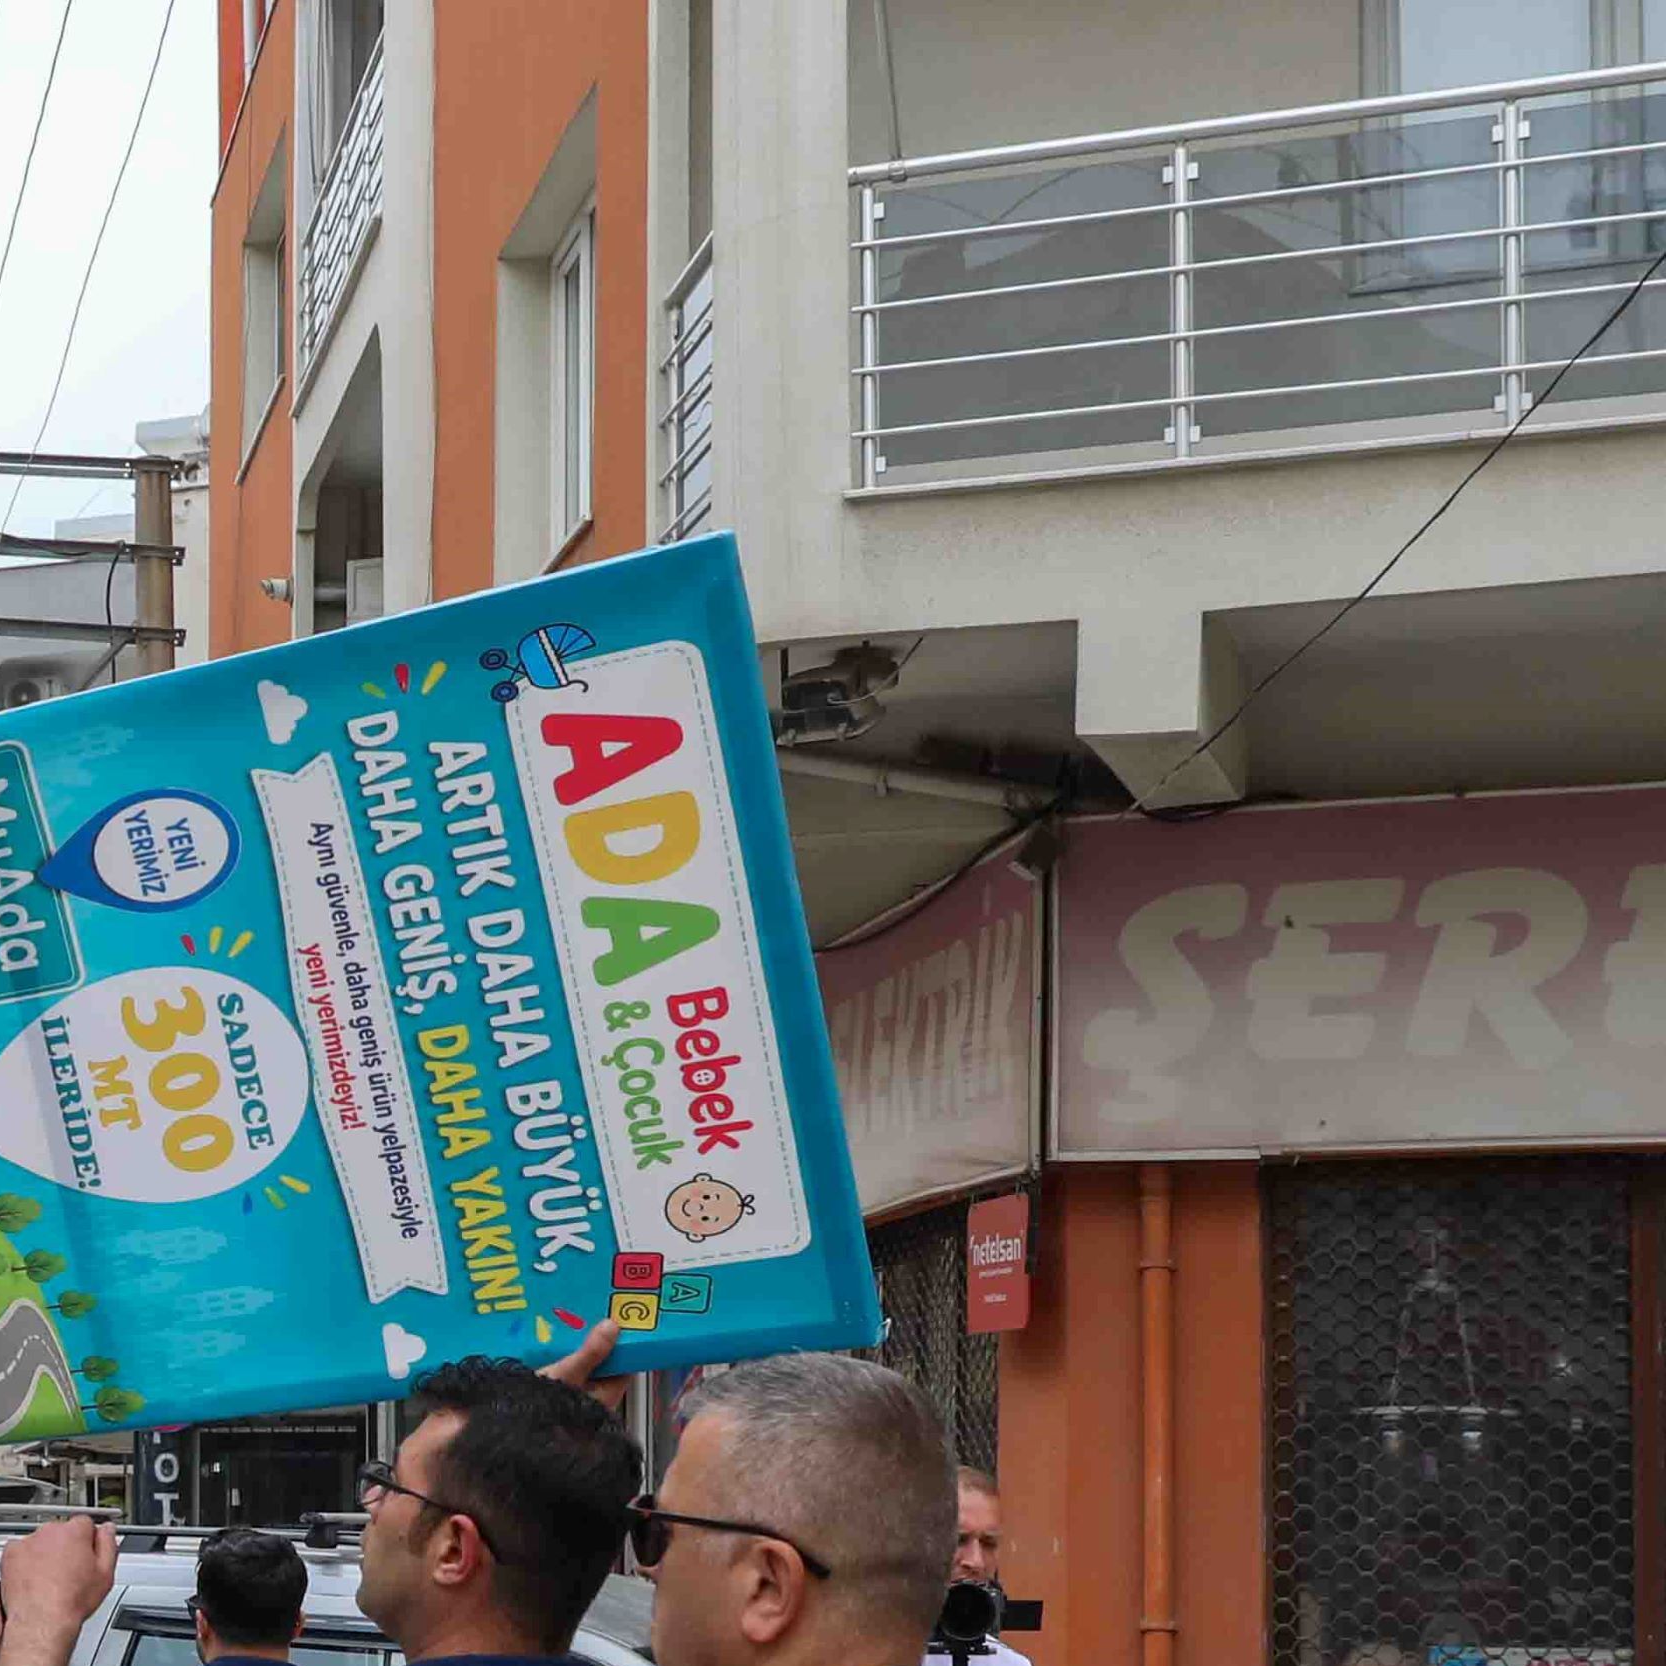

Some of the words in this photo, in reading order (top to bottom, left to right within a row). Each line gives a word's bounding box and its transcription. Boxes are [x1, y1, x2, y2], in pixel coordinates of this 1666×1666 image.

[165, 816, 207, 872] YENİ
[307, 821, 338, 868] Aynı
[347, 710, 423, 854] DAHA
[427, 741, 516, 897] ARTIK
[541, 713, 721, 986] ADA
[124, 809, 170, 897] YERİMİZ
[316, 873, 360, 957] güvenle,
[297, 943, 335, 990] yeni
[343, 961, 372, 1012] daha
[383, 863, 467, 1016] GENİŞ,
[467, 907, 551, 1069] DAHA
[120, 985, 235, 1173] 300
[218, 992, 275, 1150] SADECE
[307, 992, 368, 1131] yerimizdeyiz!
[348, 1015, 387, 1068] geniş
[603, 1000, 651, 1032] &
[666, 986, 754, 1155] Bebek
[41, 1014, 102, 1189] İLERİDE!
[87, 1055, 143, 1131] MT
[368, 1072, 396, 1119] ürün
[418, 1024, 491, 1159] DAHA
[601, 1037, 685, 1170] Çocuk
[373, 1121, 423, 1240] yelpazesiyle
[450, 1166, 528, 1315] YAKIN!
[504, 1080, 603, 1273] BÜYÜK,
